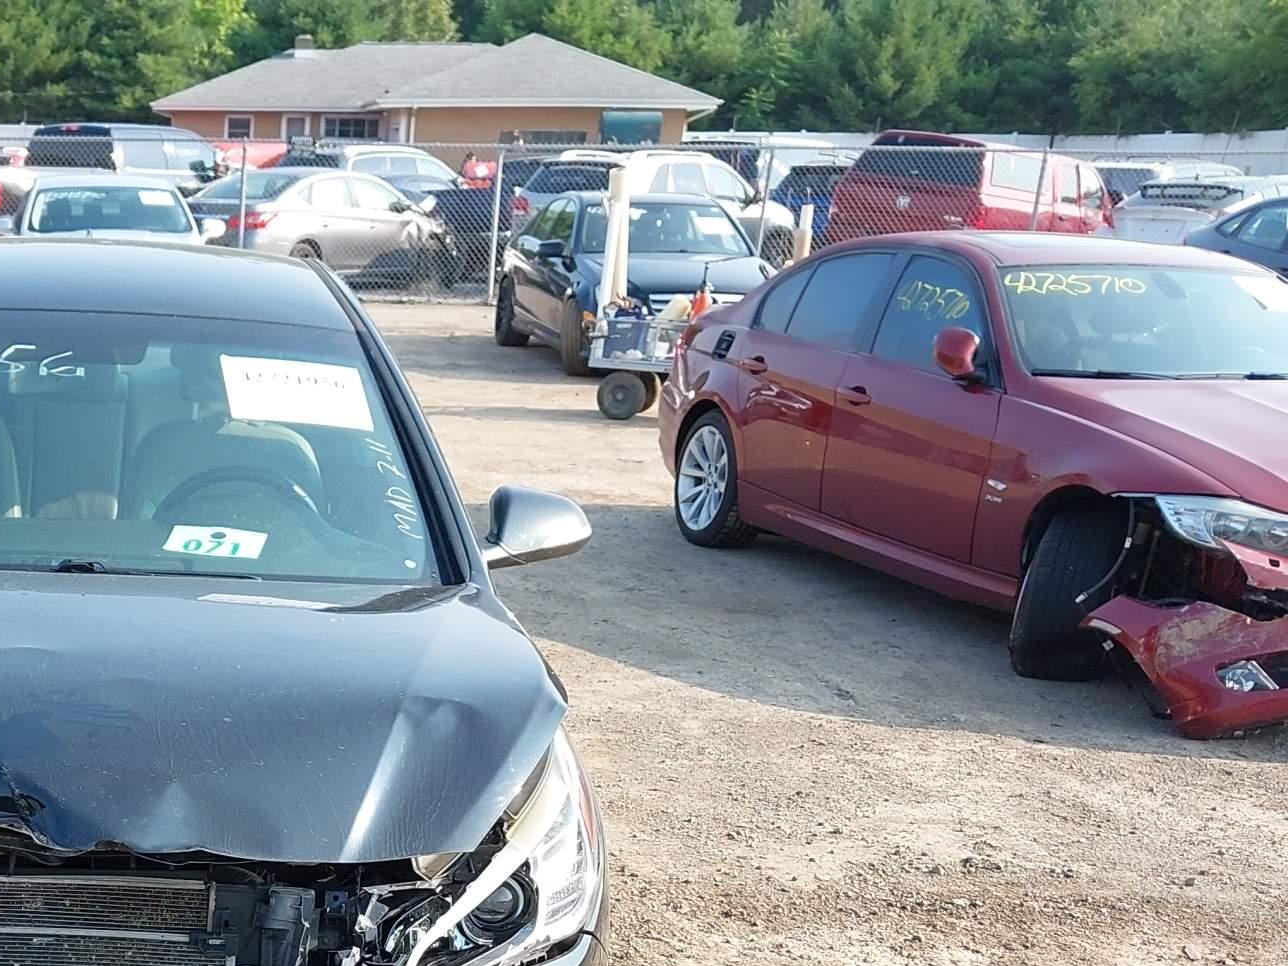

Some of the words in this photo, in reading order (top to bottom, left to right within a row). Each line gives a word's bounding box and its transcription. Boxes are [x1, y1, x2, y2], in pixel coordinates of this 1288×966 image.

[1003, 271, 1147, 296] 42725710
[384, 486, 424, 539] MAD
[182, 538, 241, 556] 071
